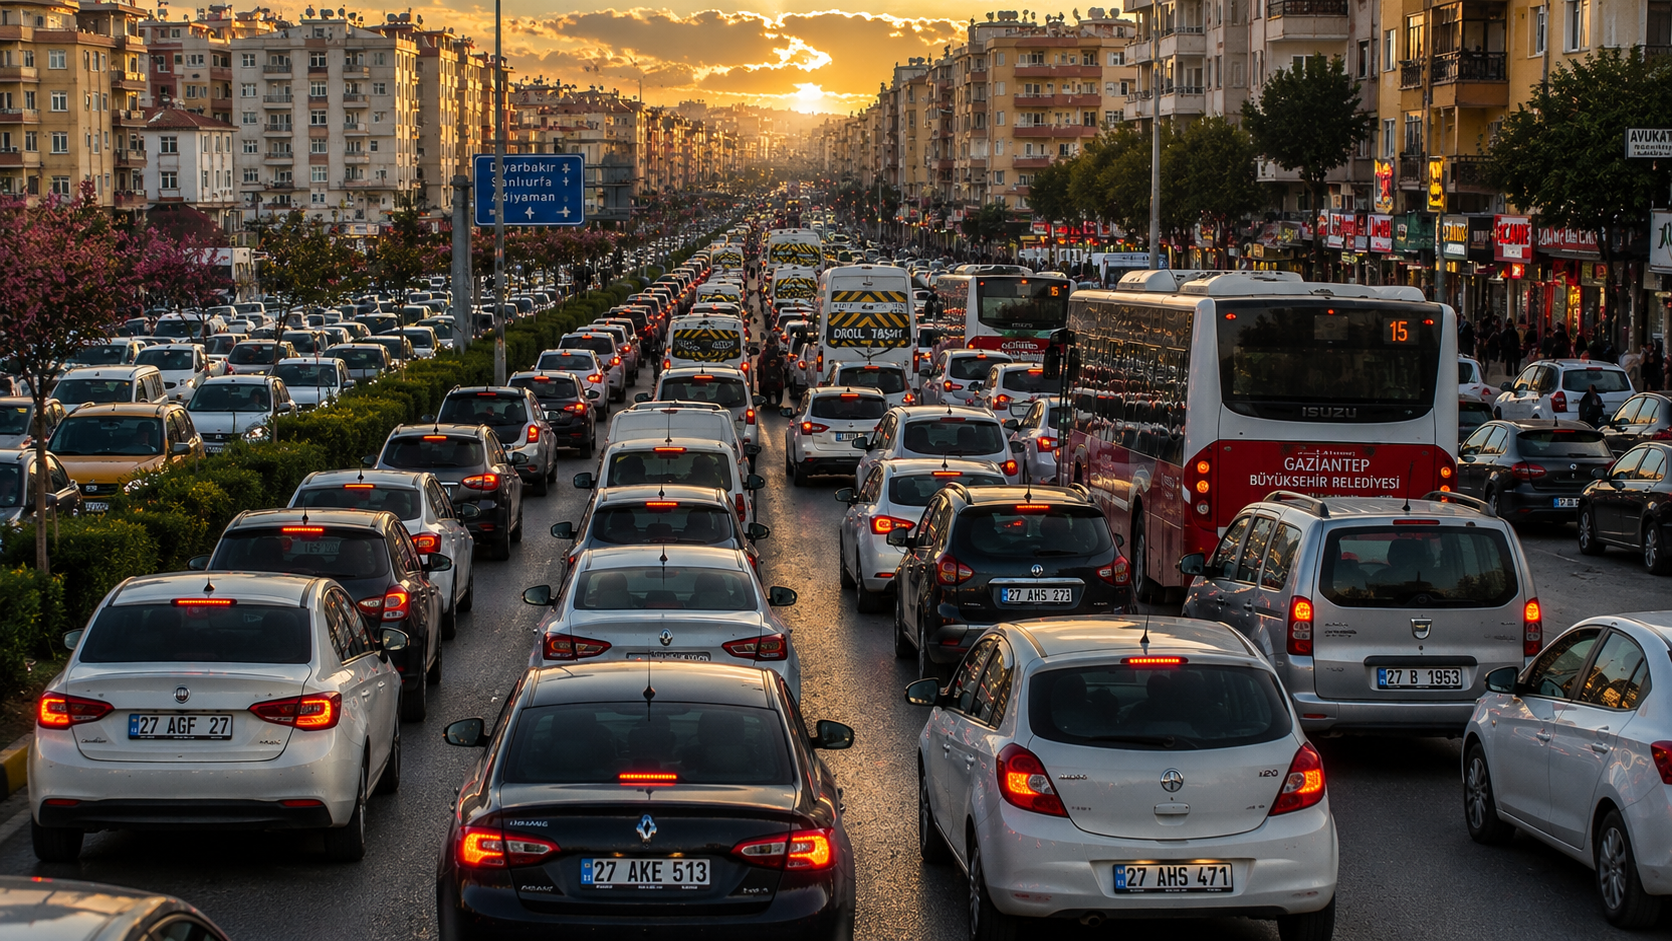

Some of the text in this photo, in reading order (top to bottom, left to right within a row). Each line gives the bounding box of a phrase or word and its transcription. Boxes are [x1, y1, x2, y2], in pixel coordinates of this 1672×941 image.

[490, 162, 556, 174] Dyarbakır
[1390, 320, 1407, 341] 15
[1284, 455, 1370, 472] GAZİANTEP
[1009, 589, 1021, 601] 27
[1027, 589, 1047, 601] AHS
[1387, 669, 1460, 685] 27 B 1953
[139, 716, 229, 734] 27 AGF 27
[594, 861, 706, 882] 27 AKE 513
[1126, 867, 1228, 886] 27 AHS 471
